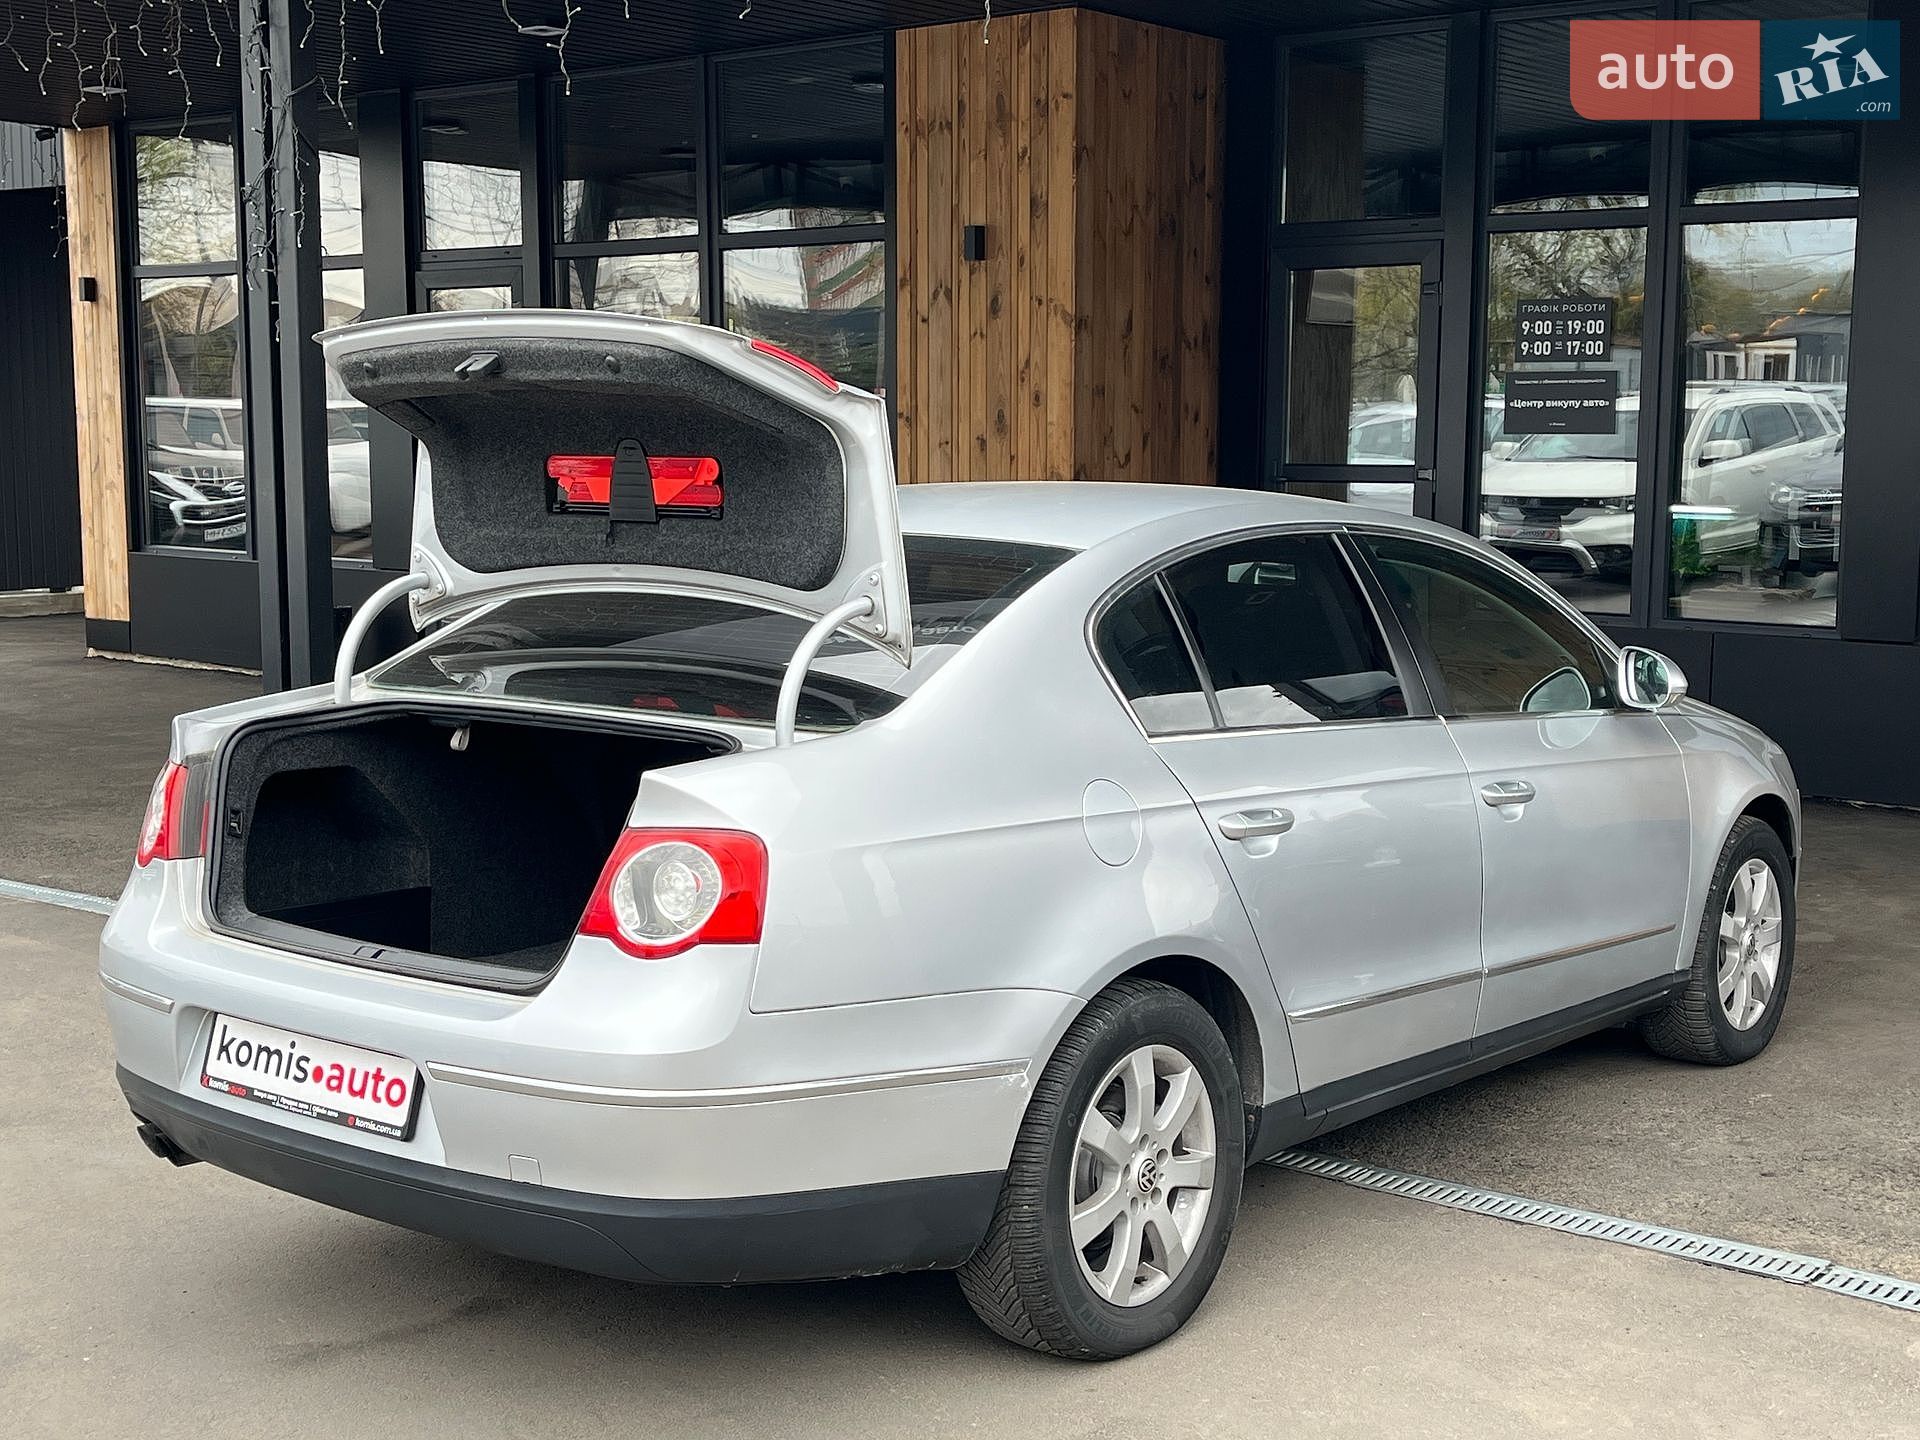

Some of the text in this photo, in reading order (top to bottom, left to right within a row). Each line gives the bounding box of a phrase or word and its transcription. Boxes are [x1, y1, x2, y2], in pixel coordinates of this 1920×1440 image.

[1522, 303, 1606, 313] ГРАФІК РОБОТИ
[1521, 319, 1605, 335] 9:00 19:00
[1520, 340, 1604, 356] 9:00 17:00
[1545, 400, 1581, 409] викупу
